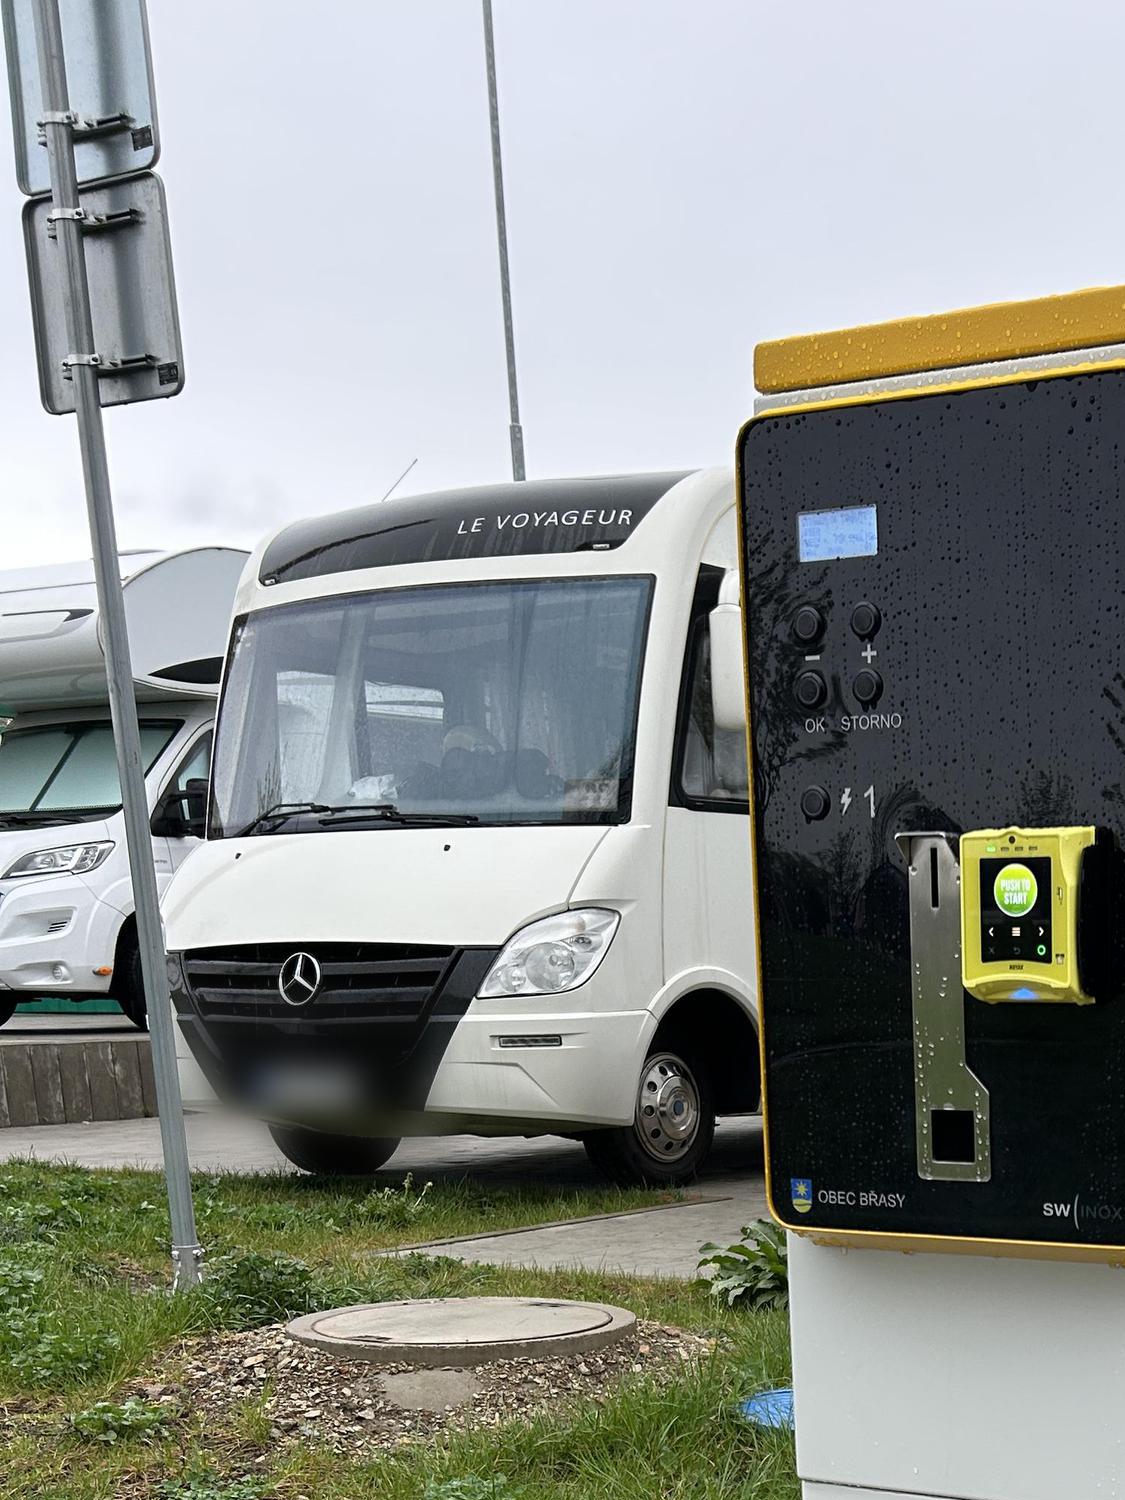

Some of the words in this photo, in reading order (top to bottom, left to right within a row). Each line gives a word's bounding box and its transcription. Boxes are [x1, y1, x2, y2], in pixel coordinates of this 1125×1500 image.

[457, 517, 485, 535] LE
[497, 509, 633, 530] VOYAGEUR
[805, 717, 825, 733] OK
[841, 713, 902, 731] STORNO
[863, 785, 876, 818] 1
[1000, 879, 1021, 892] PUSH
[1003, 891, 1028, 905] START
[818, 1190, 856, 1205] OBEC
[859, 1190, 906, 1208] BŘASY
